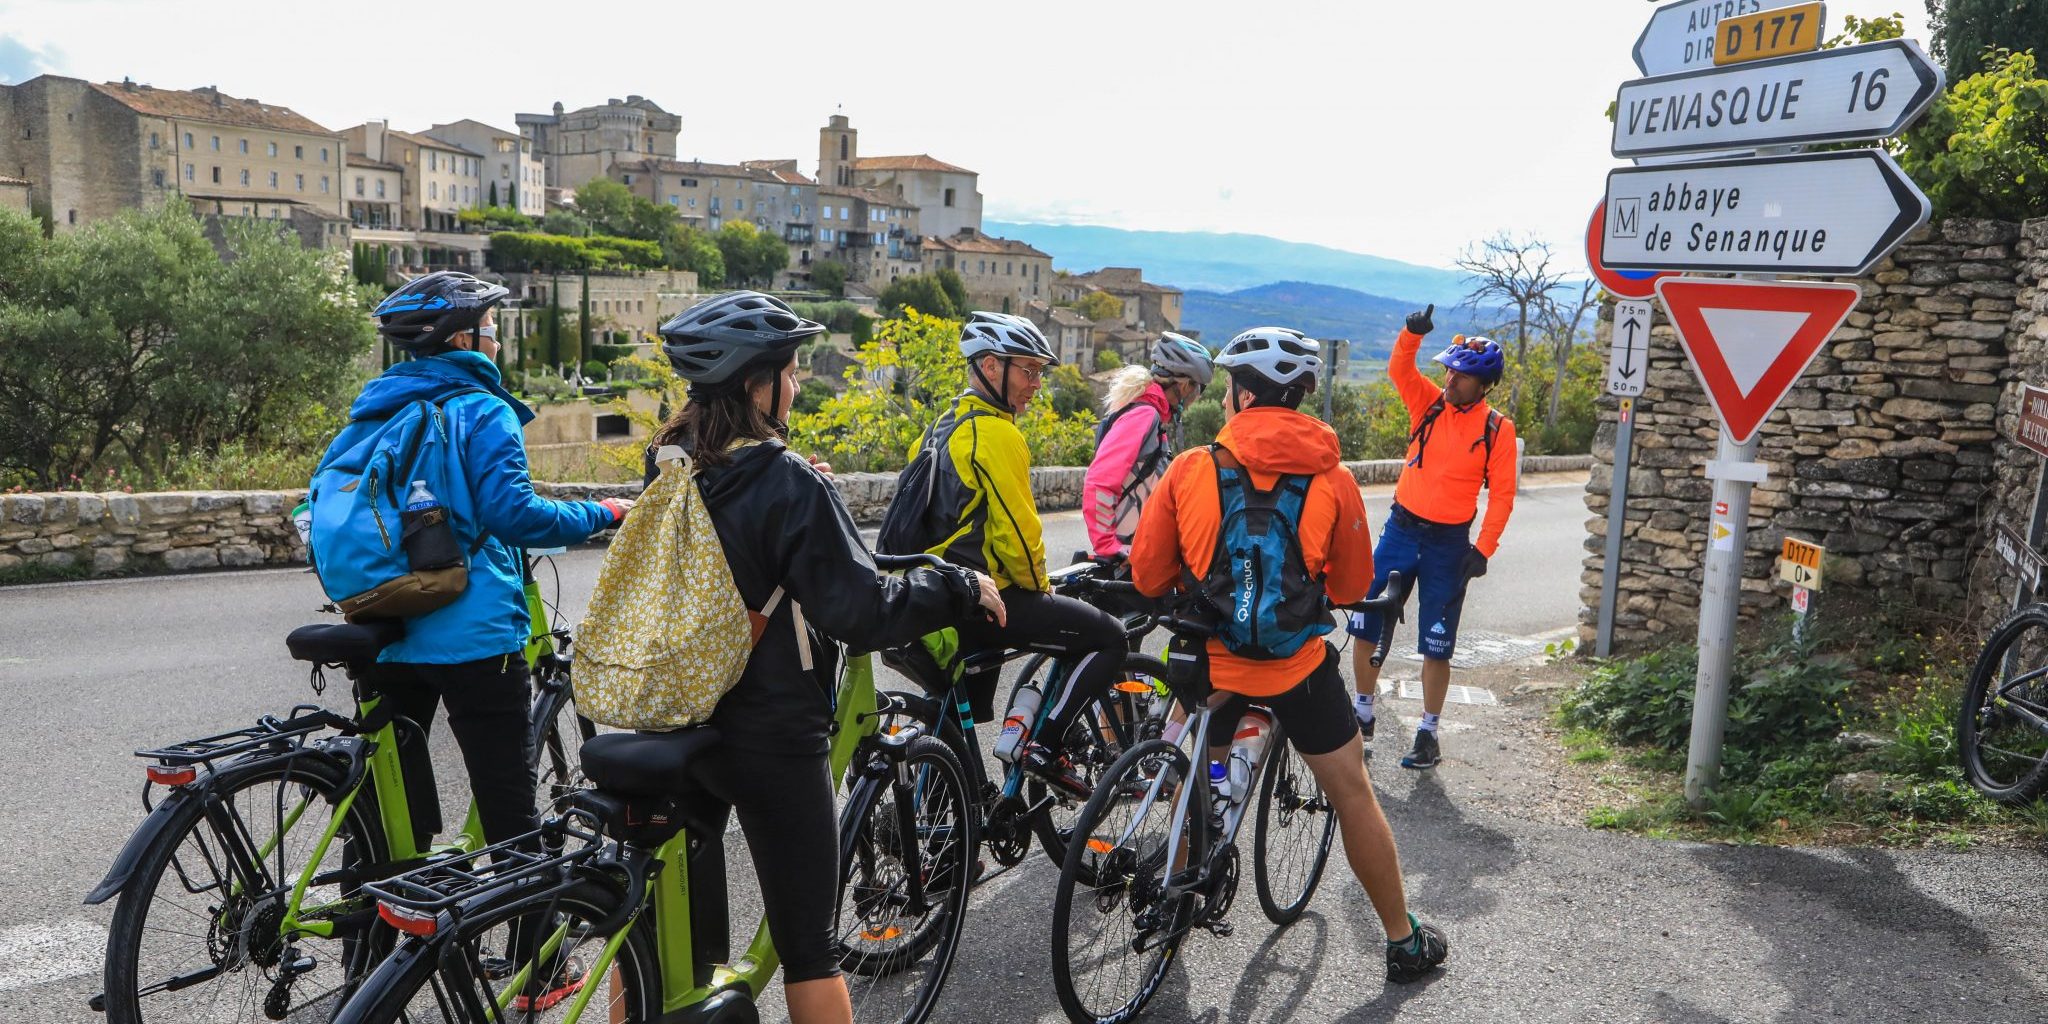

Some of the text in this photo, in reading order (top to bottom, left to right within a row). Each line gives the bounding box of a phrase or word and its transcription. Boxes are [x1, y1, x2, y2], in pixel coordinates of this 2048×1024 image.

[1753, 13, 1805, 51] 177
[1628, 67, 1890, 135] VENASQUE 16
[1648, 182, 1741, 217] abbaye
[1645, 222, 1826, 260] de Senanque
[1621, 306, 1634, 315] 75
[1613, 382, 1627, 391] 50
[1788, 542, 1816, 566] D177
[1237, 559, 1254, 622] Quechua
[1795, 565, 1803, 582] 0
